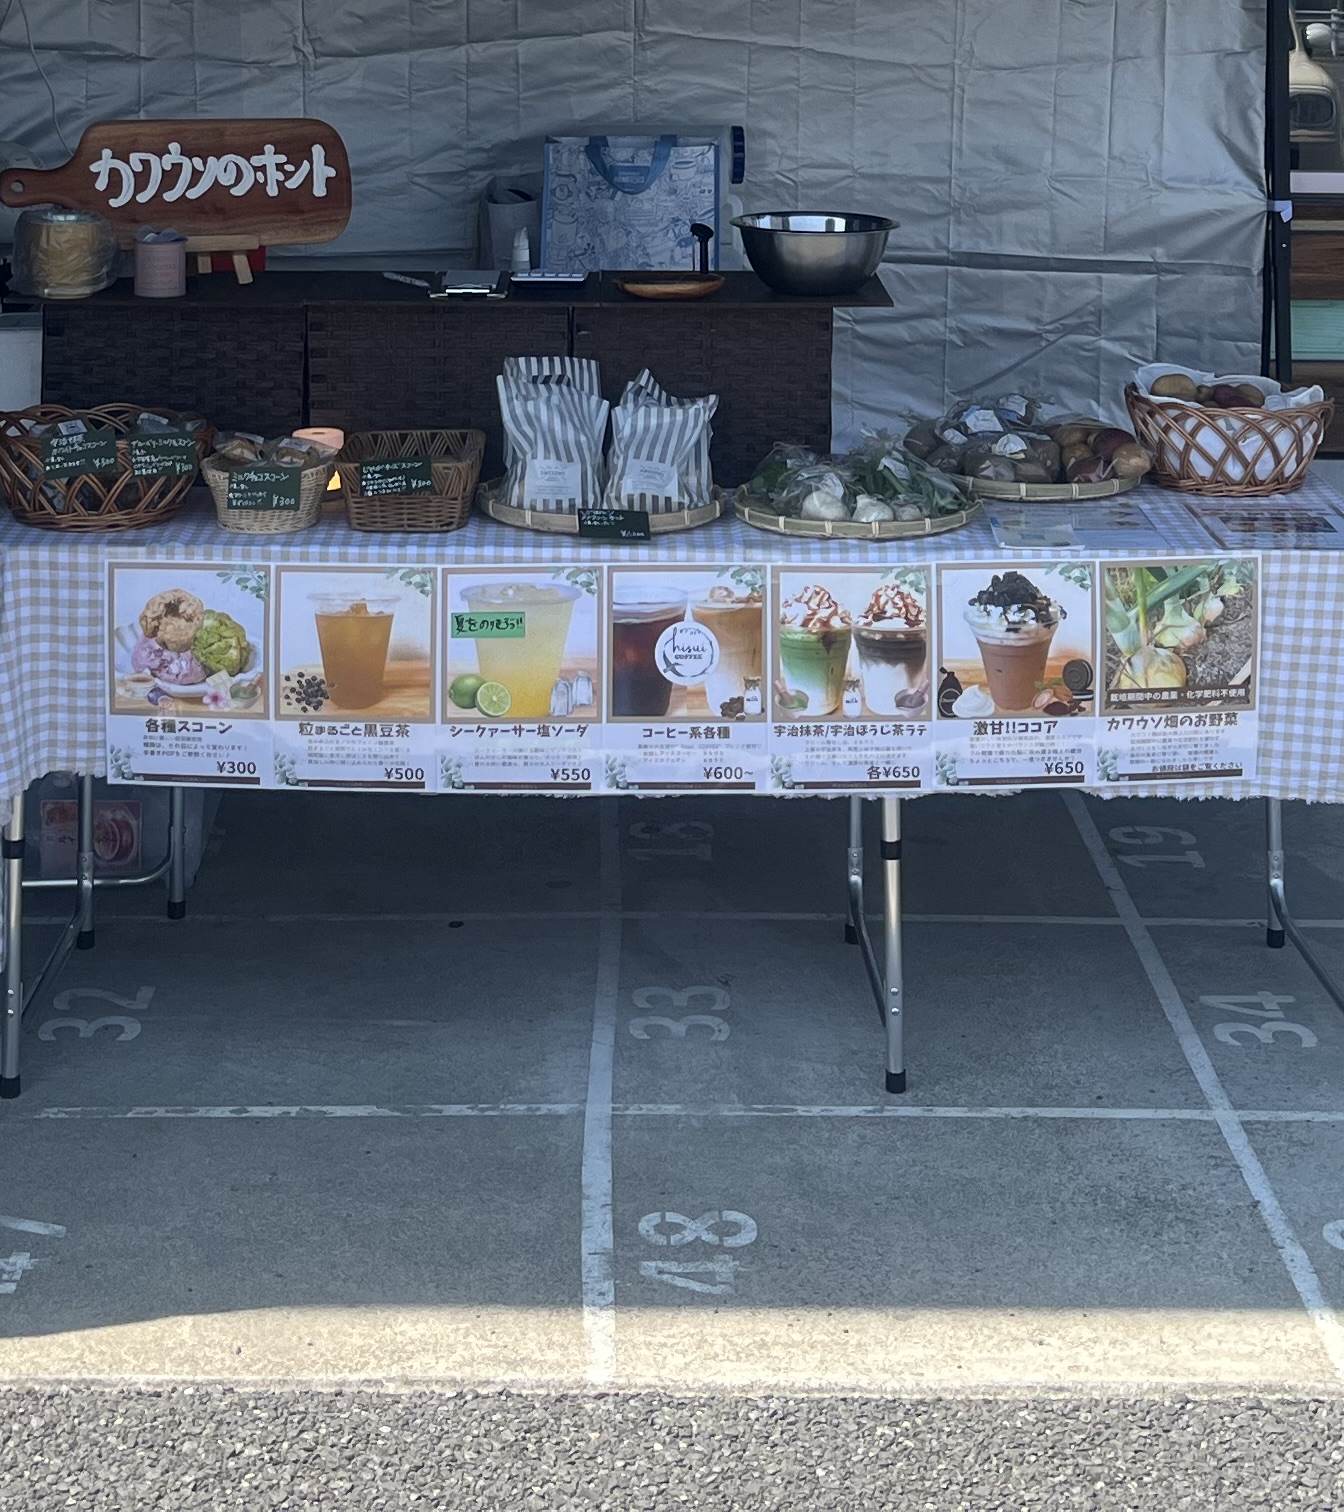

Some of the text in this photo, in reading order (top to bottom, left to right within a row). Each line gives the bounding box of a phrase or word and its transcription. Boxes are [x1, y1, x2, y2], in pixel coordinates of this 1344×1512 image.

[89, 142, 337, 208] カワウソのホント
[272, 493, 296, 508] ¥300
[145, 717, 233, 734] 各種スコーン
[298, 721, 411, 738] 粒まるごと黒豆茶
[973, 720, 1059, 736] 激甘!!ココア
[1107, 711, 1239, 732] カワウソ畑のお野菜
[449, 723, 589, 738] シークァーサー塩ソーダ
[642, 725, 731, 740] コーヒー系各種
[773, 723, 928, 738] 宇治抹茶/宇治ほうじ茶ラテ
[216, 760, 257, 775] ¥300
[384, 767, 425, 781] ¥500
[550, 767, 591, 781] ¥550
[866, 765, 920, 780] 各¥650
[1044, 761, 1085, 775] ¥650
[1108, 824, 1206, 870] 19
[37, 985, 156, 1043] 32
[629, 984, 733, 1044] 33
[1200, 990, 1318, 1048] 34
[637, 1208, 759, 1295] 48
